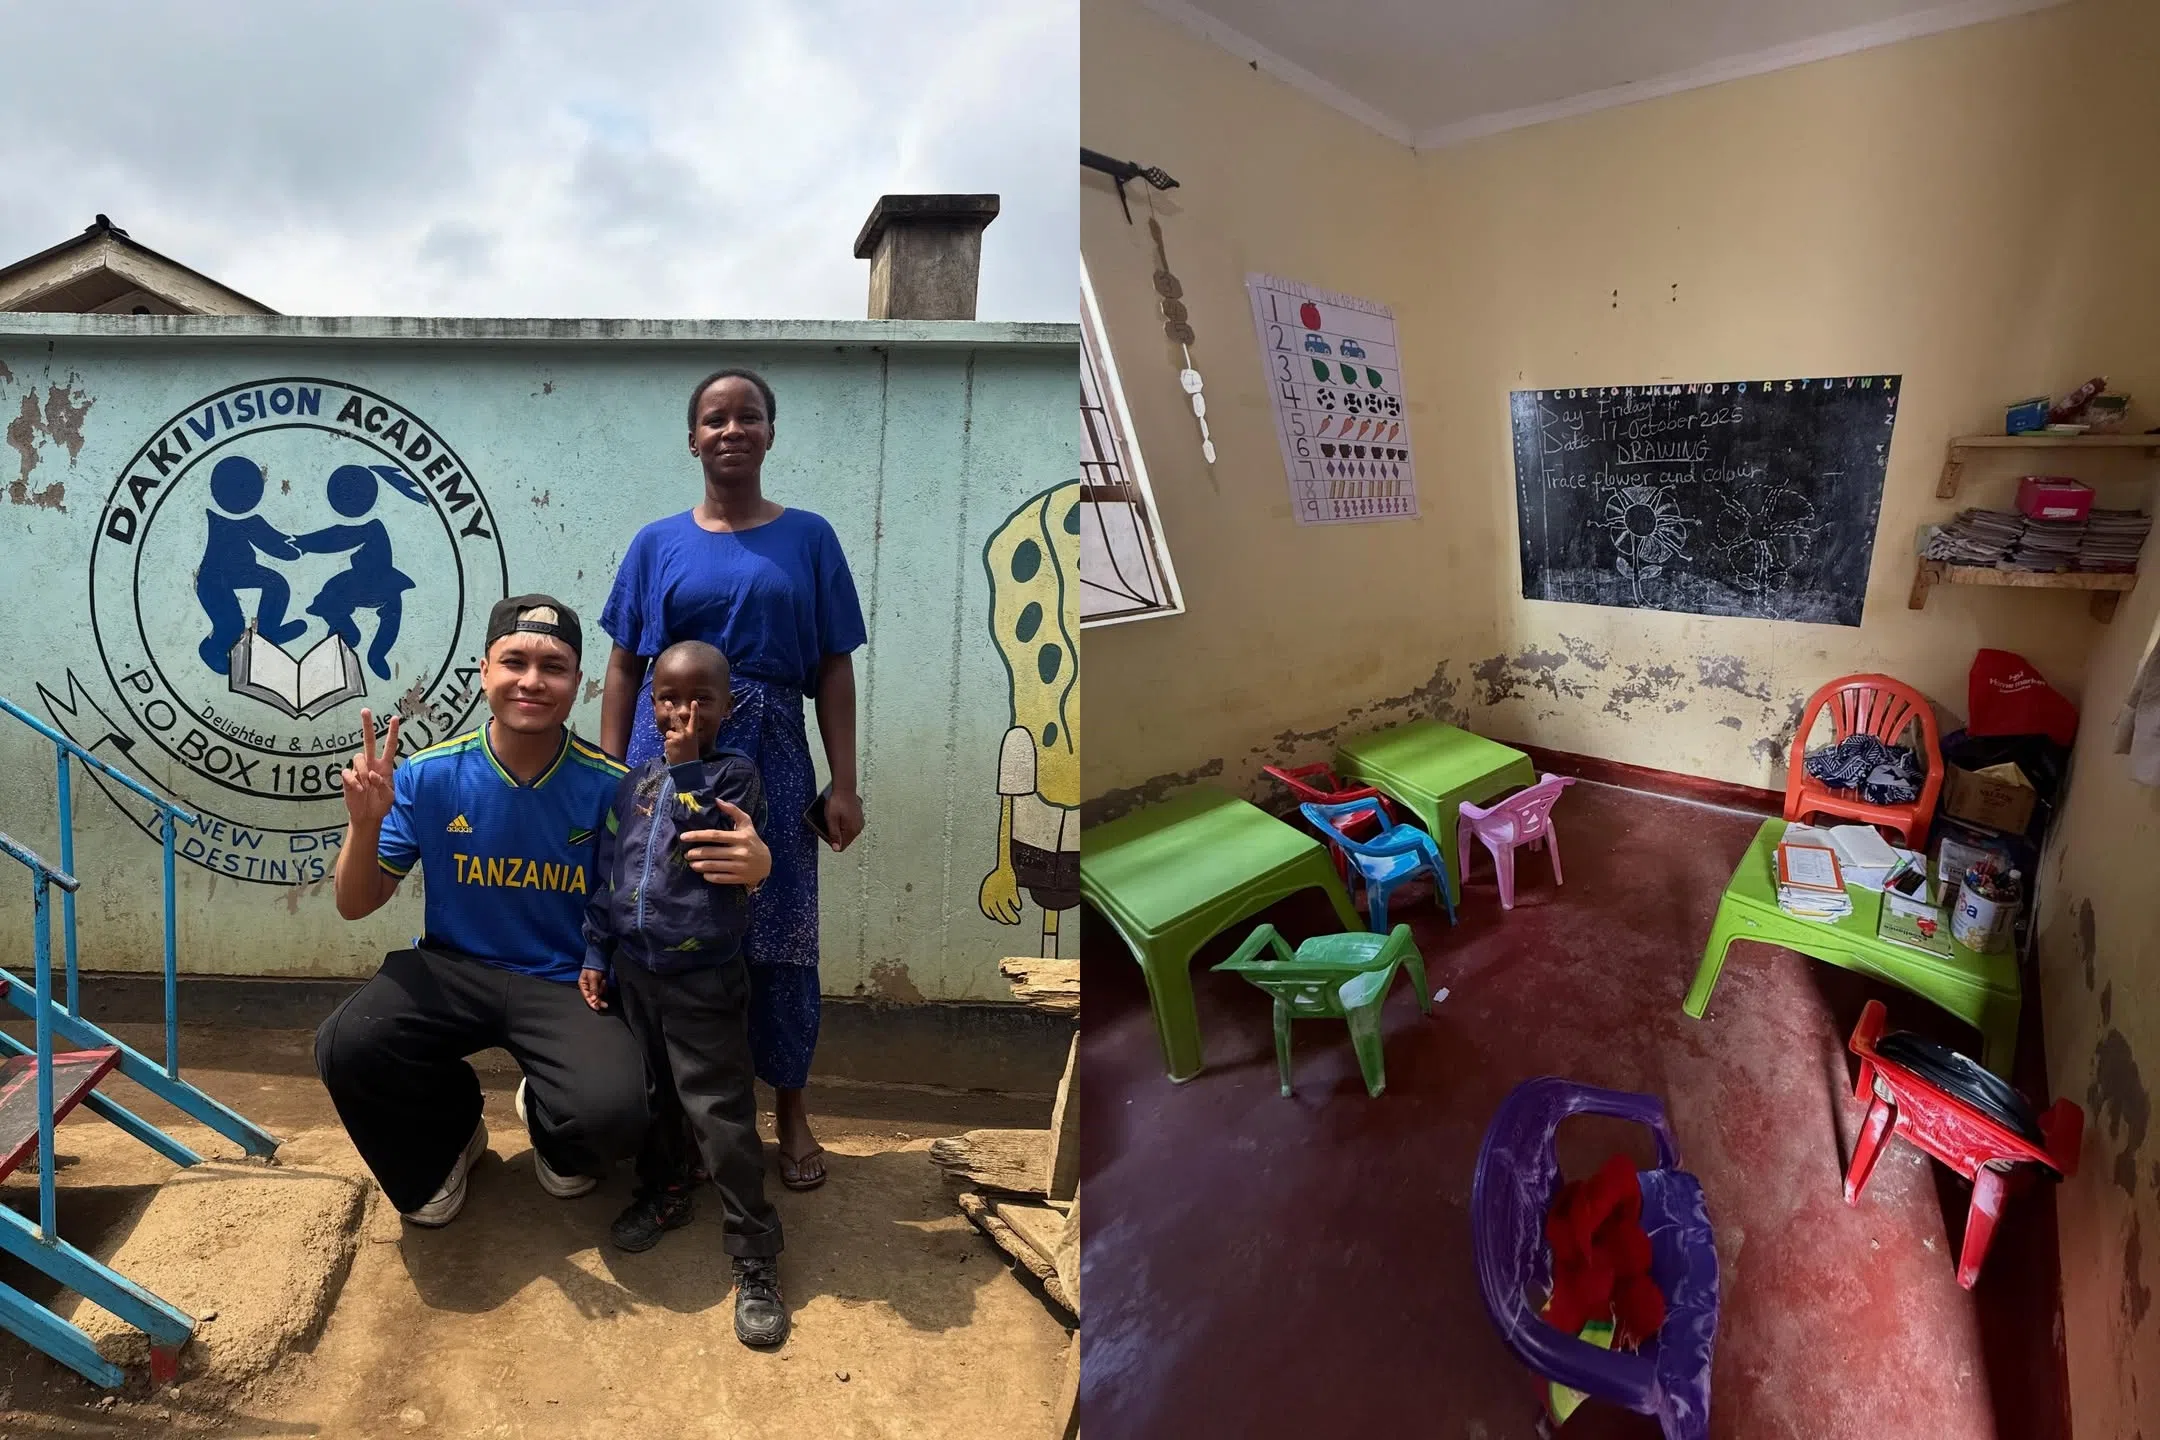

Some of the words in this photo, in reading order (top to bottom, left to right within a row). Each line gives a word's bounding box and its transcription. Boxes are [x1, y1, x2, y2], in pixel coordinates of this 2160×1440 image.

[1271, 295, 1278, 321] 1
[1271, 325, 1292, 350] 2
[1278, 355, 1292, 382] 3
[1282, 383, 1301, 408] 4
[1554, 390, 1561, 399] C
[1569, 389, 1576, 398] D
[1600, 388, 1606, 397] F
[1653, 386, 1661, 395] K
[1663, 386, 1670, 395] L
[1671, 385, 1681, 395] M
[1688, 384, 1696, 394] N
[1704, 383, 1713, 394] O
[1722, 384, 1730, 394] P
[1738, 382, 1747, 393] Q
[1763, 381, 1772, 392] R
[1784, 380, 1793, 391] S
[1801, 379, 1810, 390] T
[1824, 378, 1833, 389] U
[1847, 378, 1855, 388] V
[1860, 378, 1872, 389] W
[1883, 378, 1891, 389] X
[1887, 396, 1896, 407] Y
[1292, 413, 1305, 436] 5
[1884, 414, 1895, 425] Z
[1296, 438, 1310, 457] 6
[1617, 439, 1709, 464] DRAWING
[337, 395, 492, 543] ACADEMY
[1298, 461, 1315, 479] 7
[1544, 468, 1587, 489] Trace
[1592, 461, 1652, 501] flower
[1659, 462, 1696, 483] and
[1703, 457, 1766, 484] colour
[1305, 480, 1319, 498] 8
[1308, 500, 1320, 518] 9
[289, 737, 302, 751] &
[272, 759, 354, 793] 1186
[195, 813, 263, 849] NEW
[290, 831, 342, 853] DR
[446, 824, 473, 834] adidas
[183, 837, 325, 881] DESTINY'S
[453, 853, 587, 895] TANZANIA
